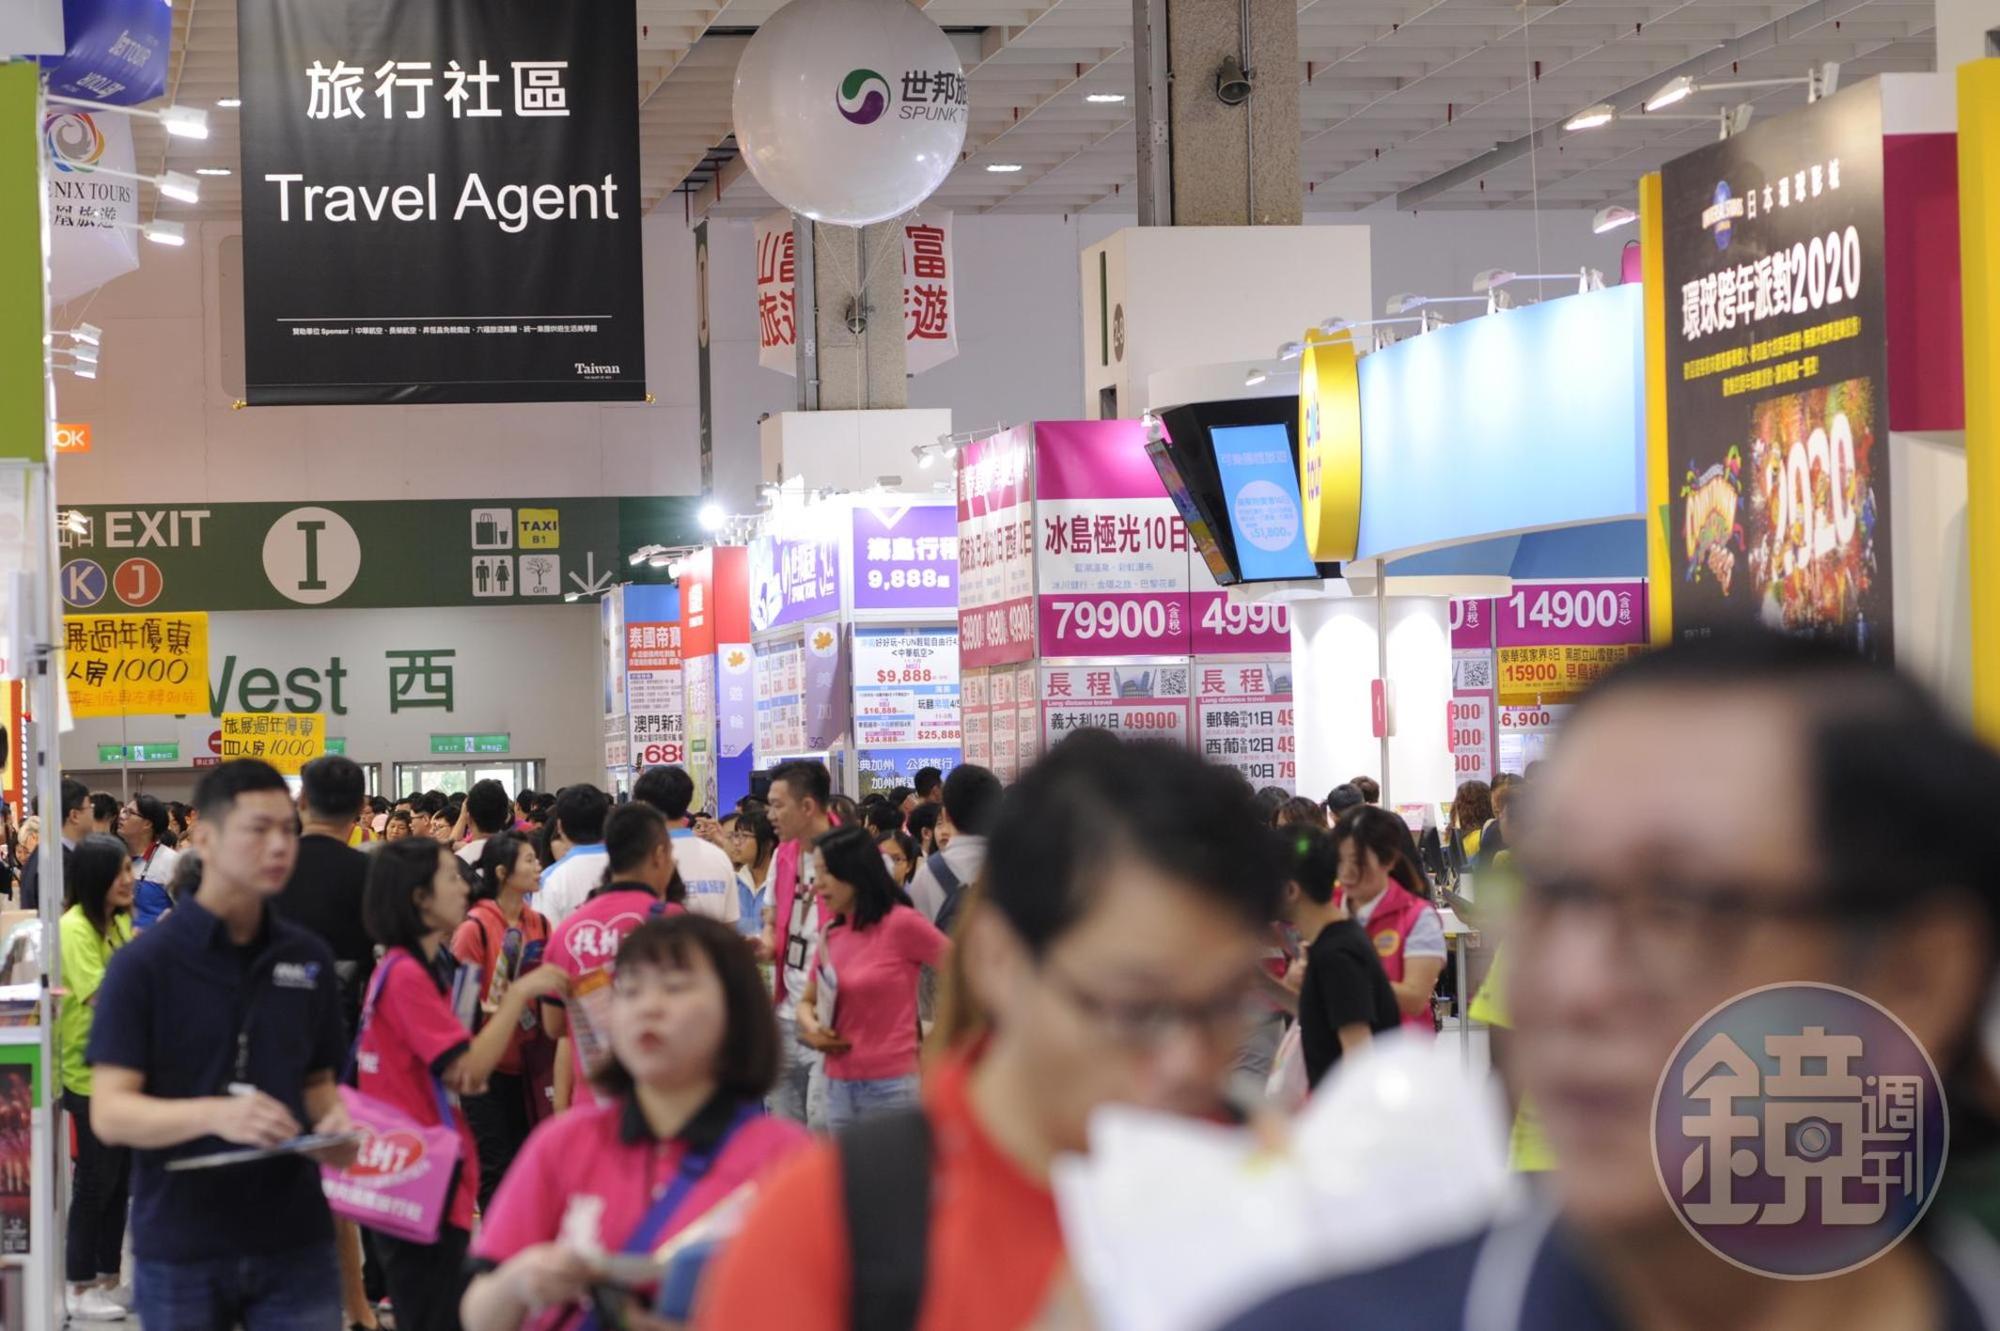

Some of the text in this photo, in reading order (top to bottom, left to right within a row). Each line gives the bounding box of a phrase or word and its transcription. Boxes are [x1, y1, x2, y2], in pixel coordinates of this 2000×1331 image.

[306, 60, 571, 119] 旅行社區
[89, 182, 131, 202] TOURS
[265, 173, 619, 234] Travel Agent
[903, 224, 945, 279] 富
[904, 284, 948, 340] 遊
[321, 327, 349, 337] Sponsor
[574, 363, 620, 374] Taiwan
[105, 510, 211, 548] EXIT
[521, 521, 557, 532] TAXI
[532, 535, 547, 544] B1
[1045, 514, 1188, 554] 冰島極光10日
[70, 565, 146, 600] K J
[533, 586, 549, 594] Gift
[1052, 600, 1166, 640] 79900
[1202, 598, 1292, 635] 4990
[1509, 590, 1617, 629] 14900
[113, 658, 189, 685] 1000
[385, 649, 456, 713] 西
[877, 669, 932, 684] $9,888
[1047, 671, 1113, 697] 長程
[1202, 668, 1265, 694] 長程
[1506, 663, 1557, 681] 15900
[1051, 711, 1177, 730] 義大利12日 49900
[1498, 711, 1550, 728] 6,900
[270, 739, 316, 757] 1000
